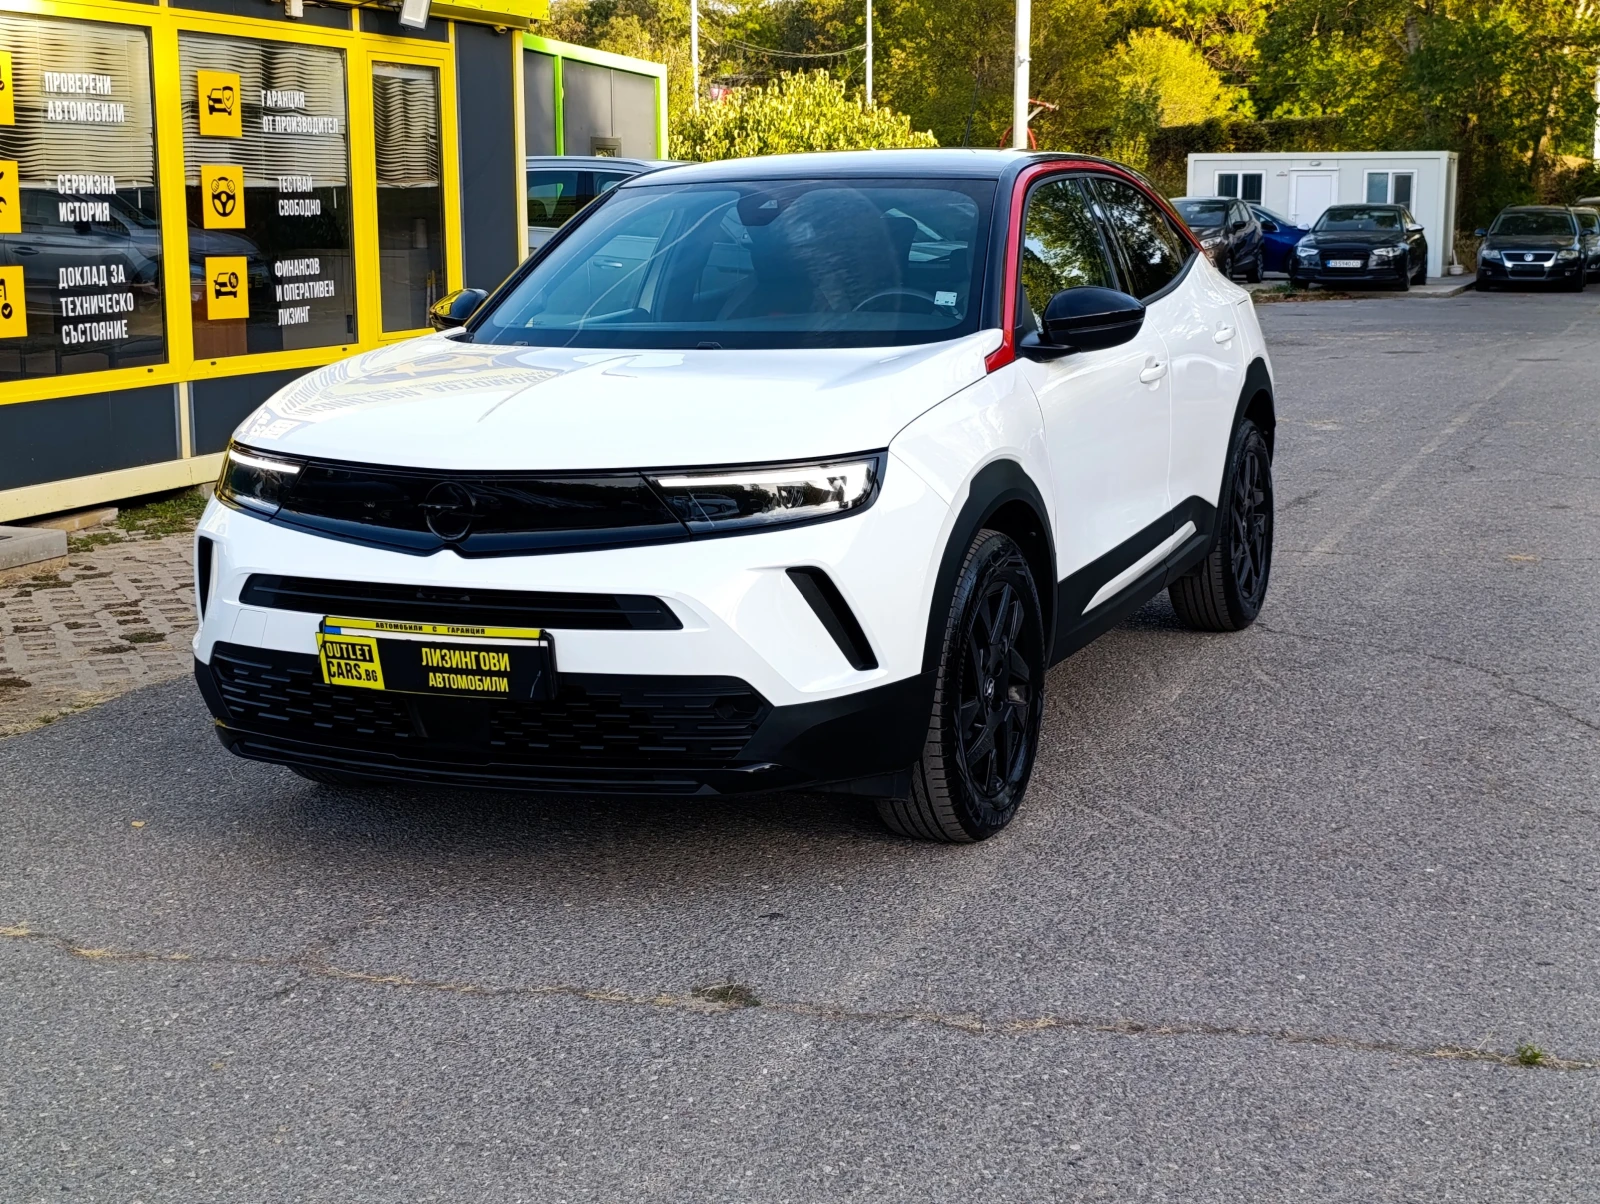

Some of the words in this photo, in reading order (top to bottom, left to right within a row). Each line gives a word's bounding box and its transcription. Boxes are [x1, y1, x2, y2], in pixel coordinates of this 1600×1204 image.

[44, 71, 112, 95] ПРОВЕРЕНИ
[261, 90, 305, 109] ГАРАНЦИЯ
[47, 100, 125, 123] АВТОМОБИЛИ
[262, 115, 274, 132] ОТ
[275, 116, 339, 134] ПРОИЗВОДИТЕЛ
[57, 174, 117, 195] СЕРВИЗНА
[277, 174, 313, 193] ТЕСТВАЙ
[58, 202, 111, 222] ИСТОРИЯ
[278, 199, 321, 217] СВОБОДНО
[58, 265, 109, 290] ДОКЛАД
[110, 264, 126, 284] ЗА
[274, 257, 320, 277] ФИНАНСОВ
[275, 284, 283, 302] И
[283, 280, 335, 301] ОПЕРАТИВЕН
[59, 292, 134, 317] ТЕХНИЧЕСКО
[277, 306, 311, 326] ЛИЗИНГ
[61, 319, 129, 345] СЪСТОЯНИЕ
[375, 622, 423, 632] АВТОМОБИЛИ
[447, 627, 486, 635] ГАРАНЦИЯ
[325, 642, 370, 660] OUTLET
[421, 647, 511, 672] ЛИЗИНГОВИ
[327, 660, 378, 682] CARS.BG
[428, 671, 509, 693] АВТОМОБИЛИ
